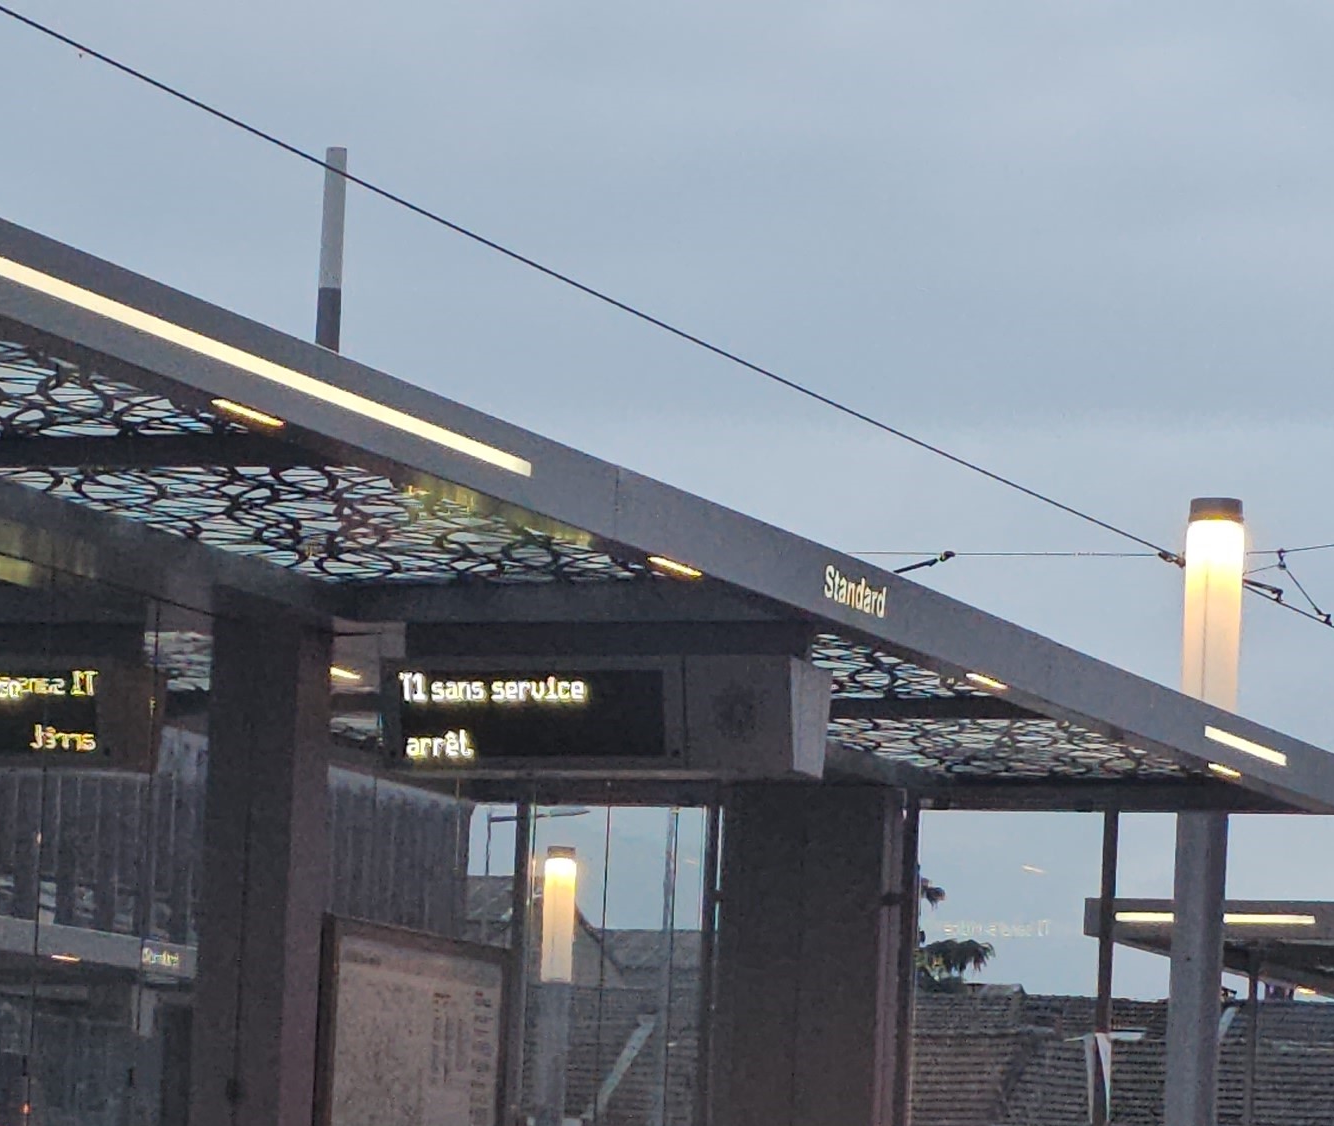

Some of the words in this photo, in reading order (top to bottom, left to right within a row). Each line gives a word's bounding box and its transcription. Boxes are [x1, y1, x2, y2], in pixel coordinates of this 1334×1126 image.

[823, 564, 888, 619] Standard
[399, 671, 426, 702] T1
[431, 680, 487, 702] sans
[490, 677, 586, 702] service
[405, 729, 474, 758] arrêt
